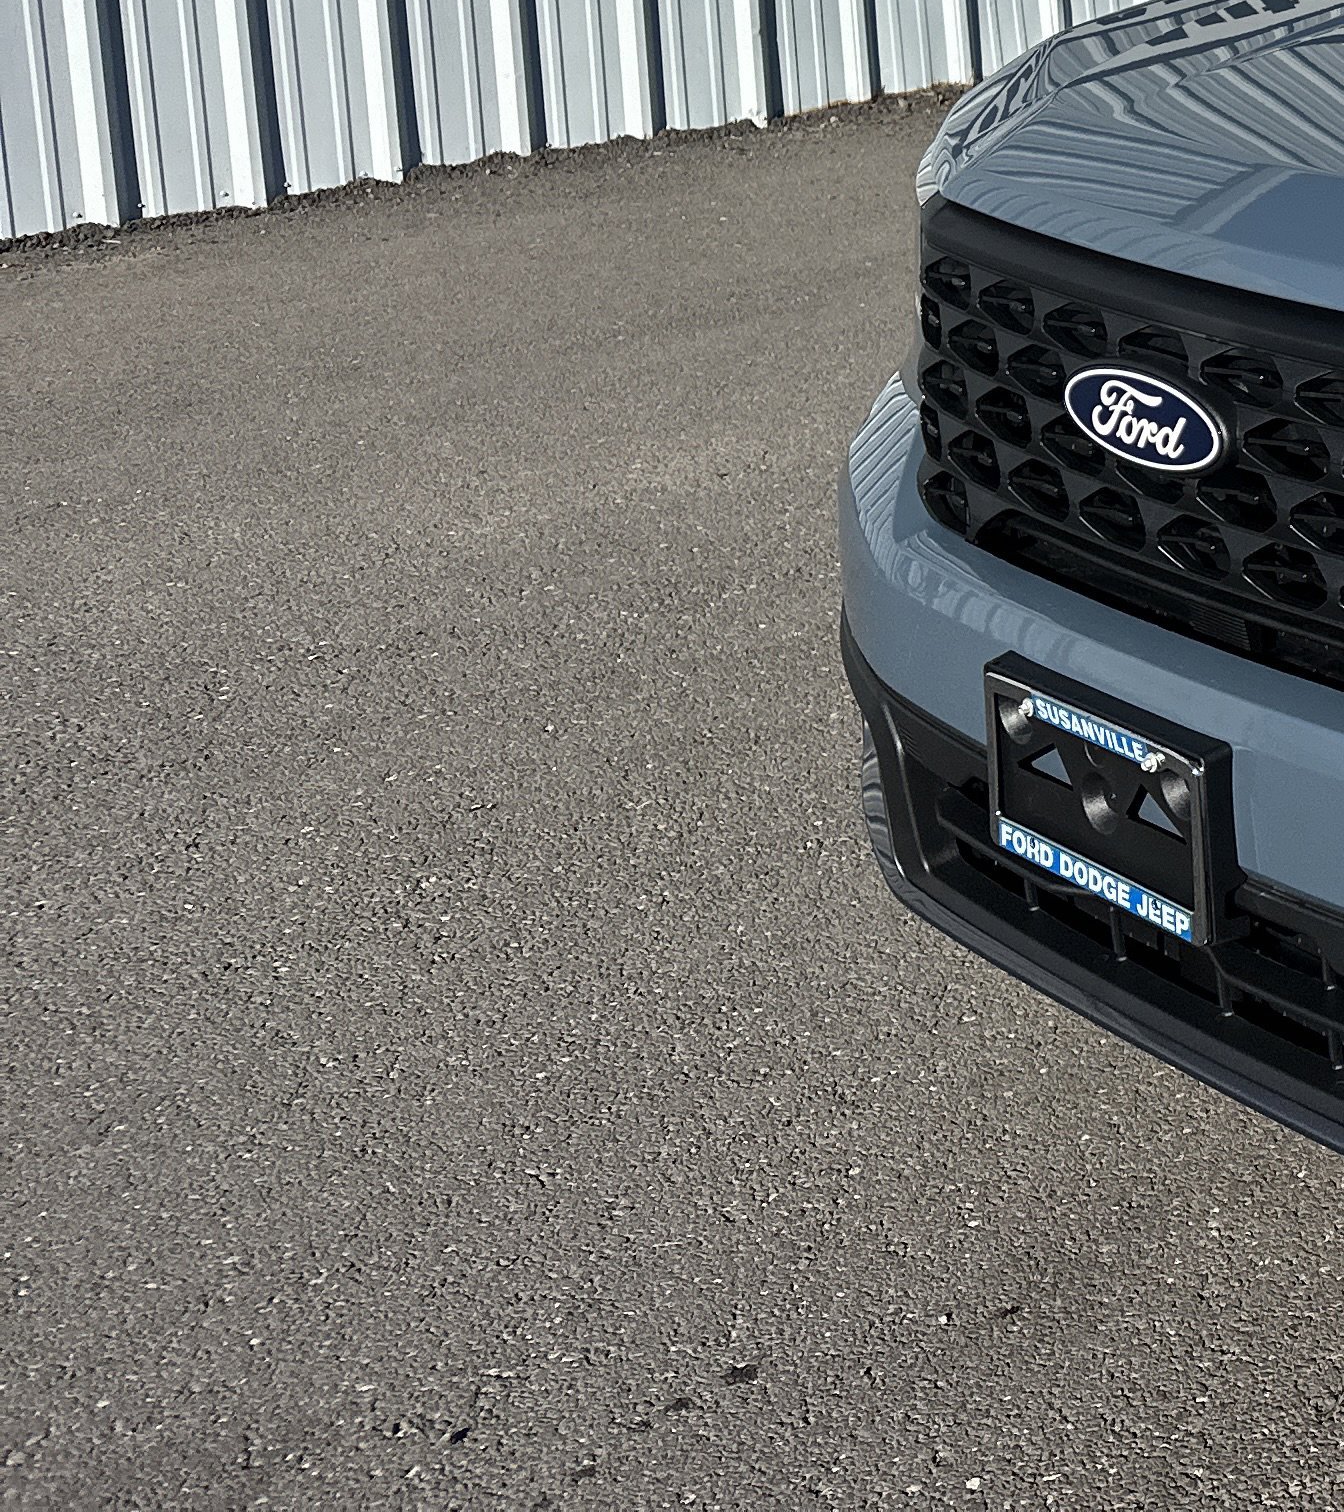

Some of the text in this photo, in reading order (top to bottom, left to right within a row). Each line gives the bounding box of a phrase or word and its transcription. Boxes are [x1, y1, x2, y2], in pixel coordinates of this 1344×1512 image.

[1091, 379, 1187, 459] Ford
[1036, 699, 1144, 761] SUSANVILLE
[1000, 824, 1190, 936] FORD DODGE JEEP
